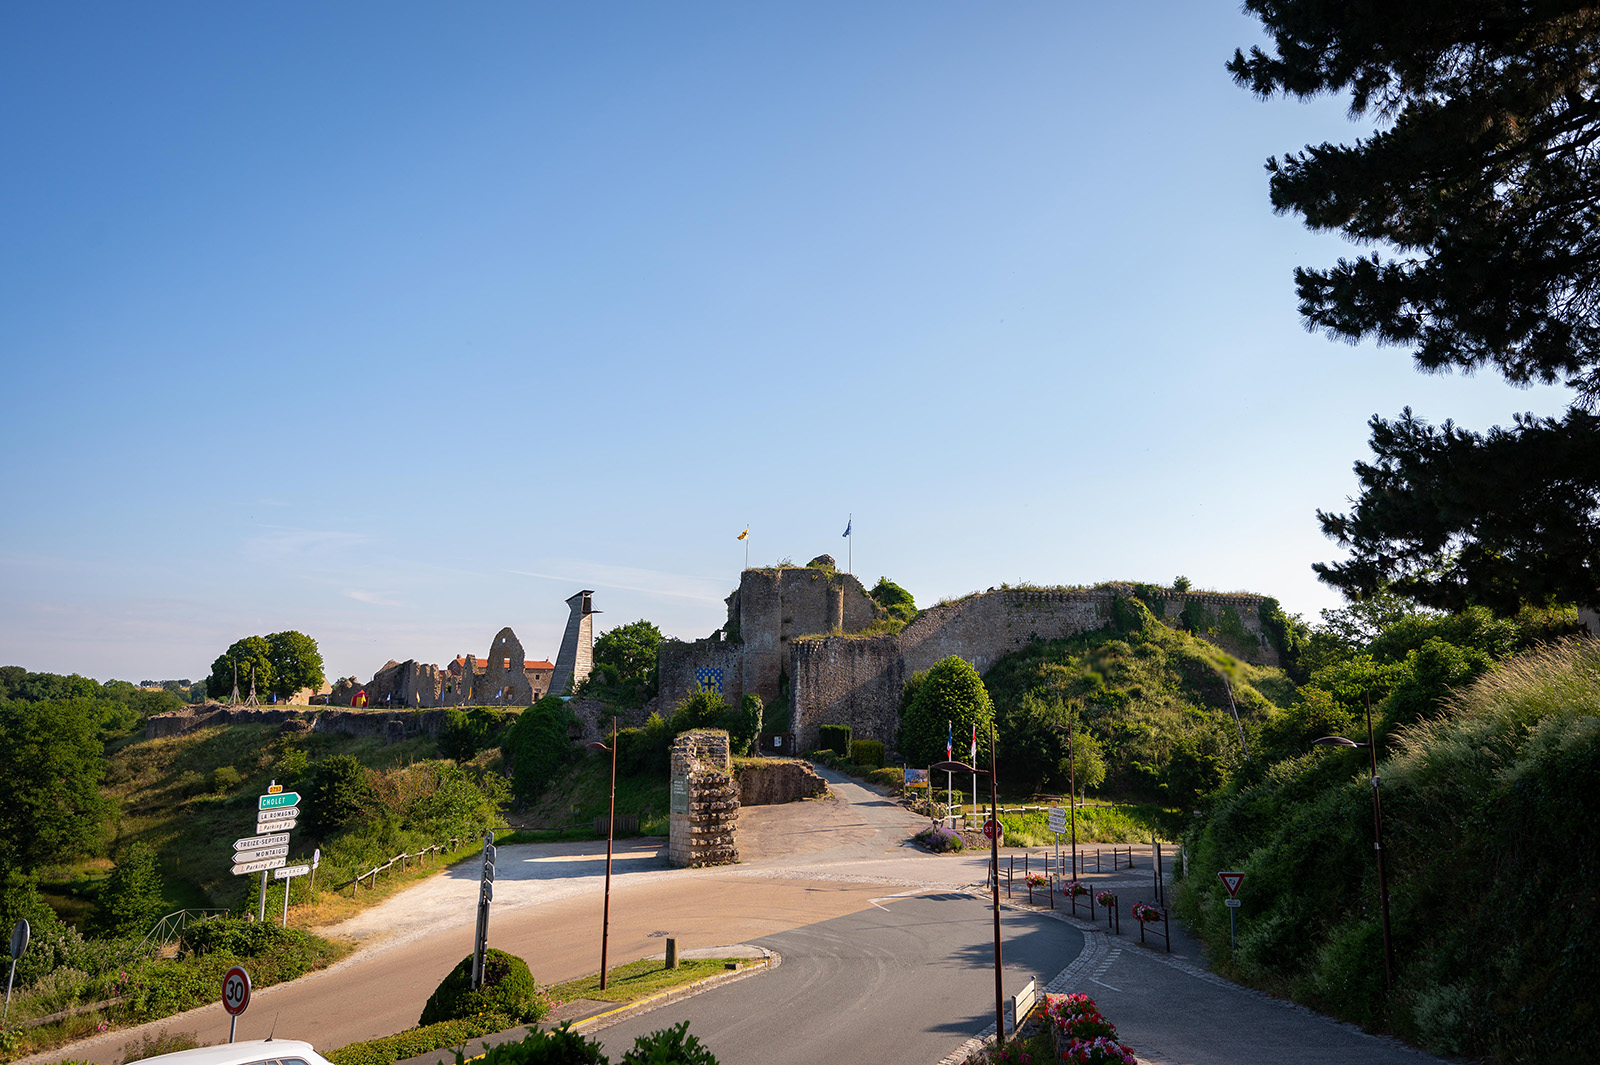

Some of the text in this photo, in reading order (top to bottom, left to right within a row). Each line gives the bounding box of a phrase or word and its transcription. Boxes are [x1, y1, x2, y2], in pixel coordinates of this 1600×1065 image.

[262, 797, 286, 806] CHOLET
[270, 810, 295, 818] ROMAGNE
[240, 836, 287, 848] TREIZE-SEPTIERS
[255, 848, 286, 858] MONTAIGU
[246, 862, 267, 871] Parking
[226, 980, 244, 1002] 30
